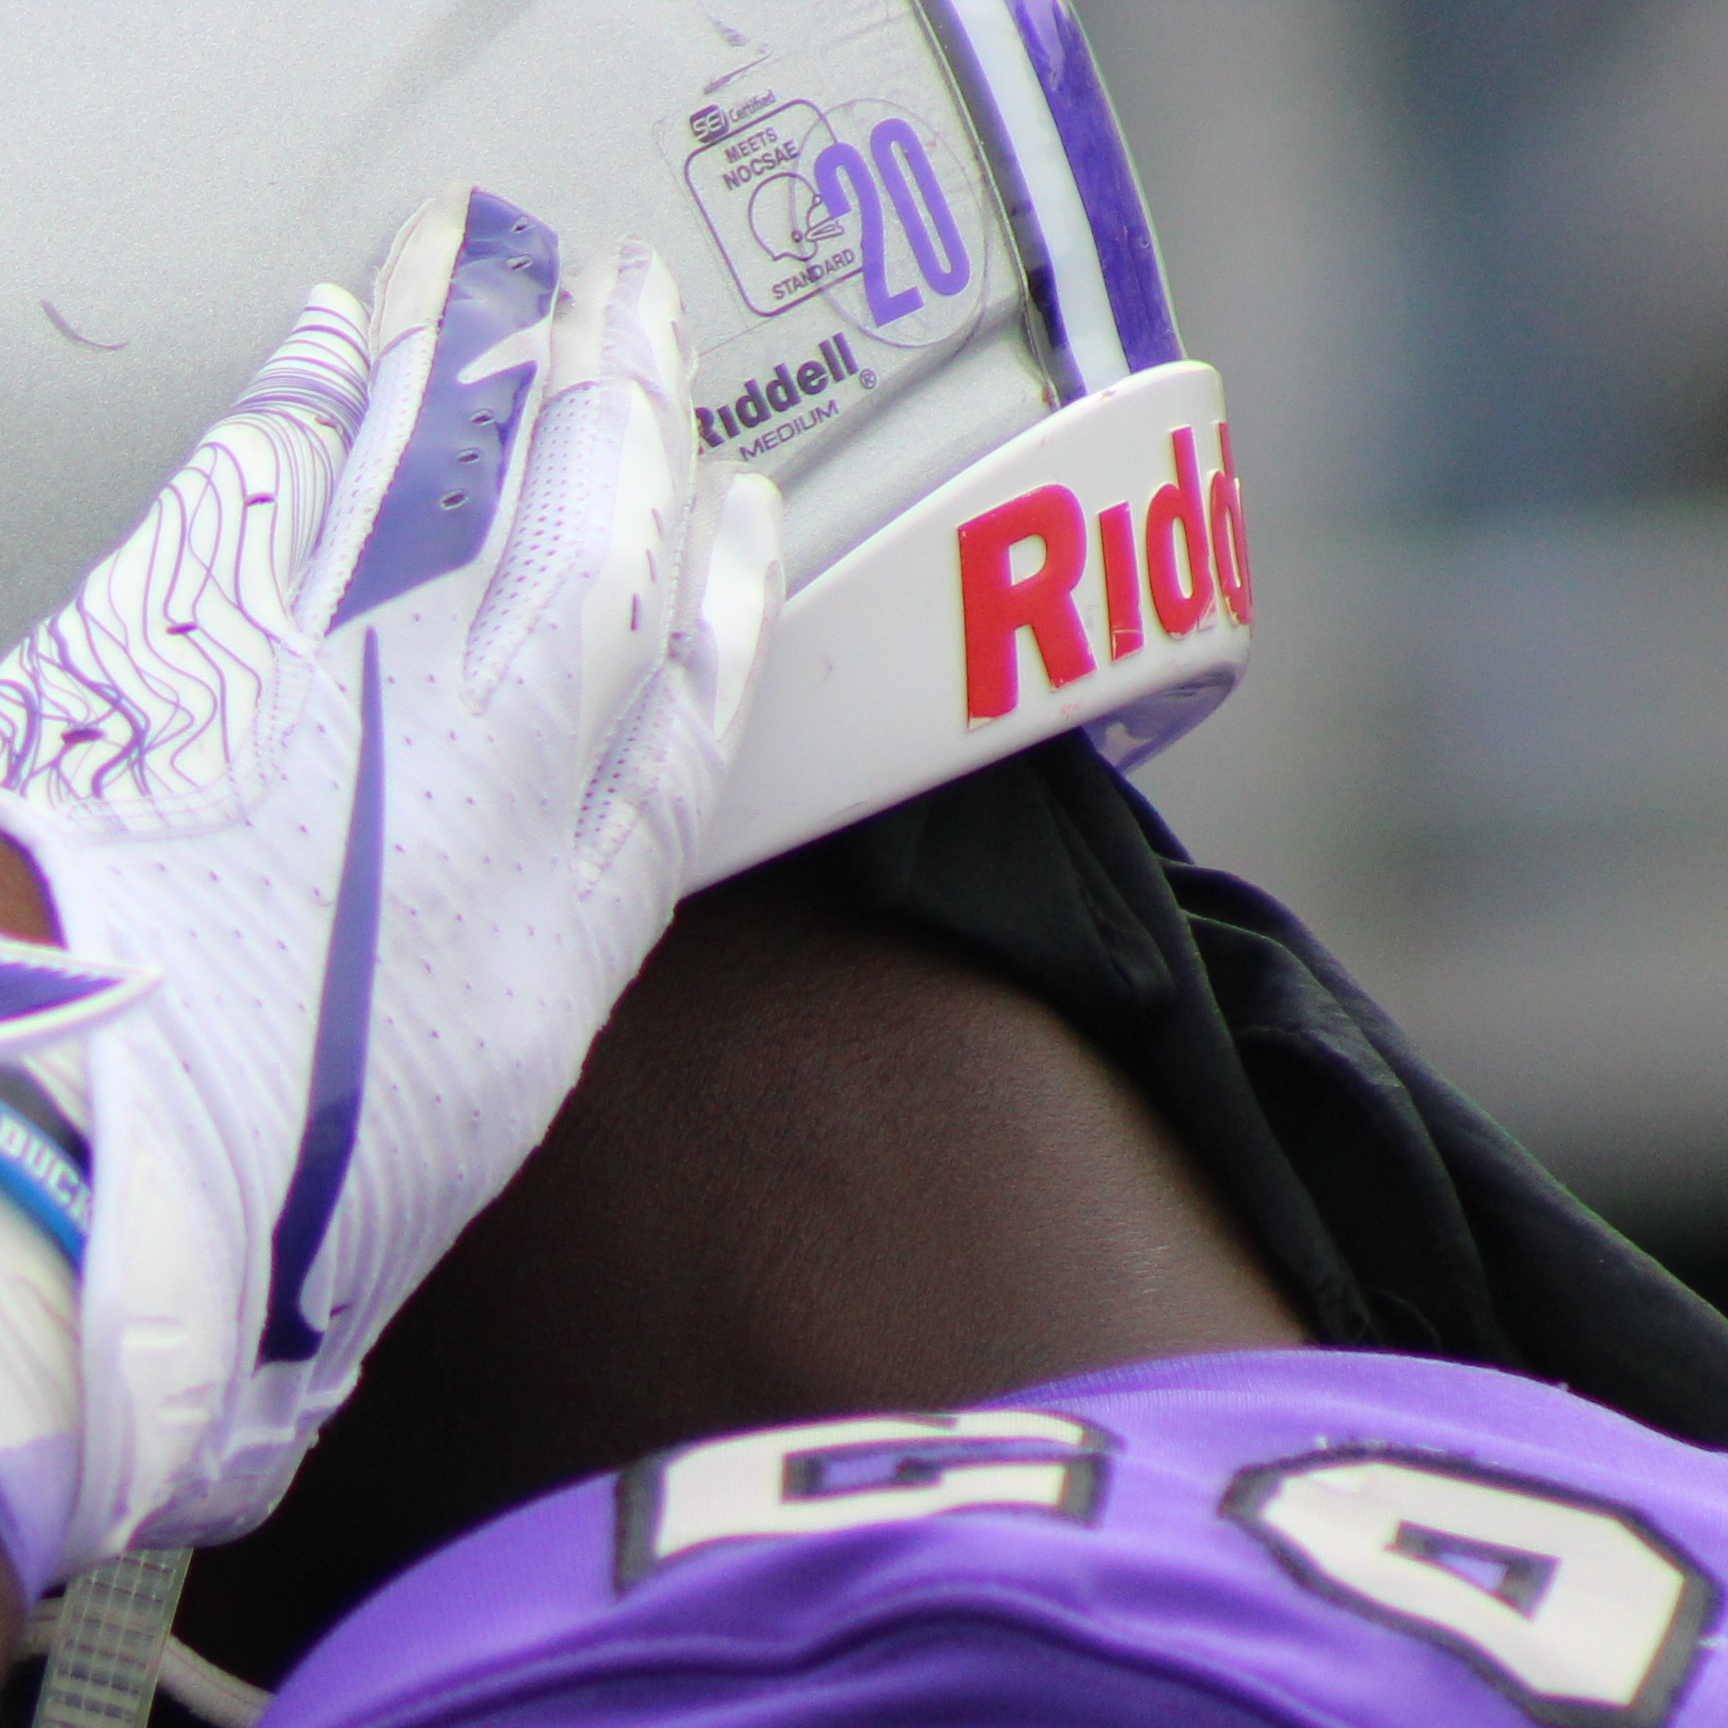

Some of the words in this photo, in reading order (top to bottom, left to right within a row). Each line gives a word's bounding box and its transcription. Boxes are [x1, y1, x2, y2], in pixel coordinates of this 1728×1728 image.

[722, 140, 799, 190] NOCSAE
[724, 127, 778, 163] MEETS
[814, 118, 970, 327] 20
[772, 248, 855, 300] STANDARD
[739, 399, 840, 461] MEDIUM
